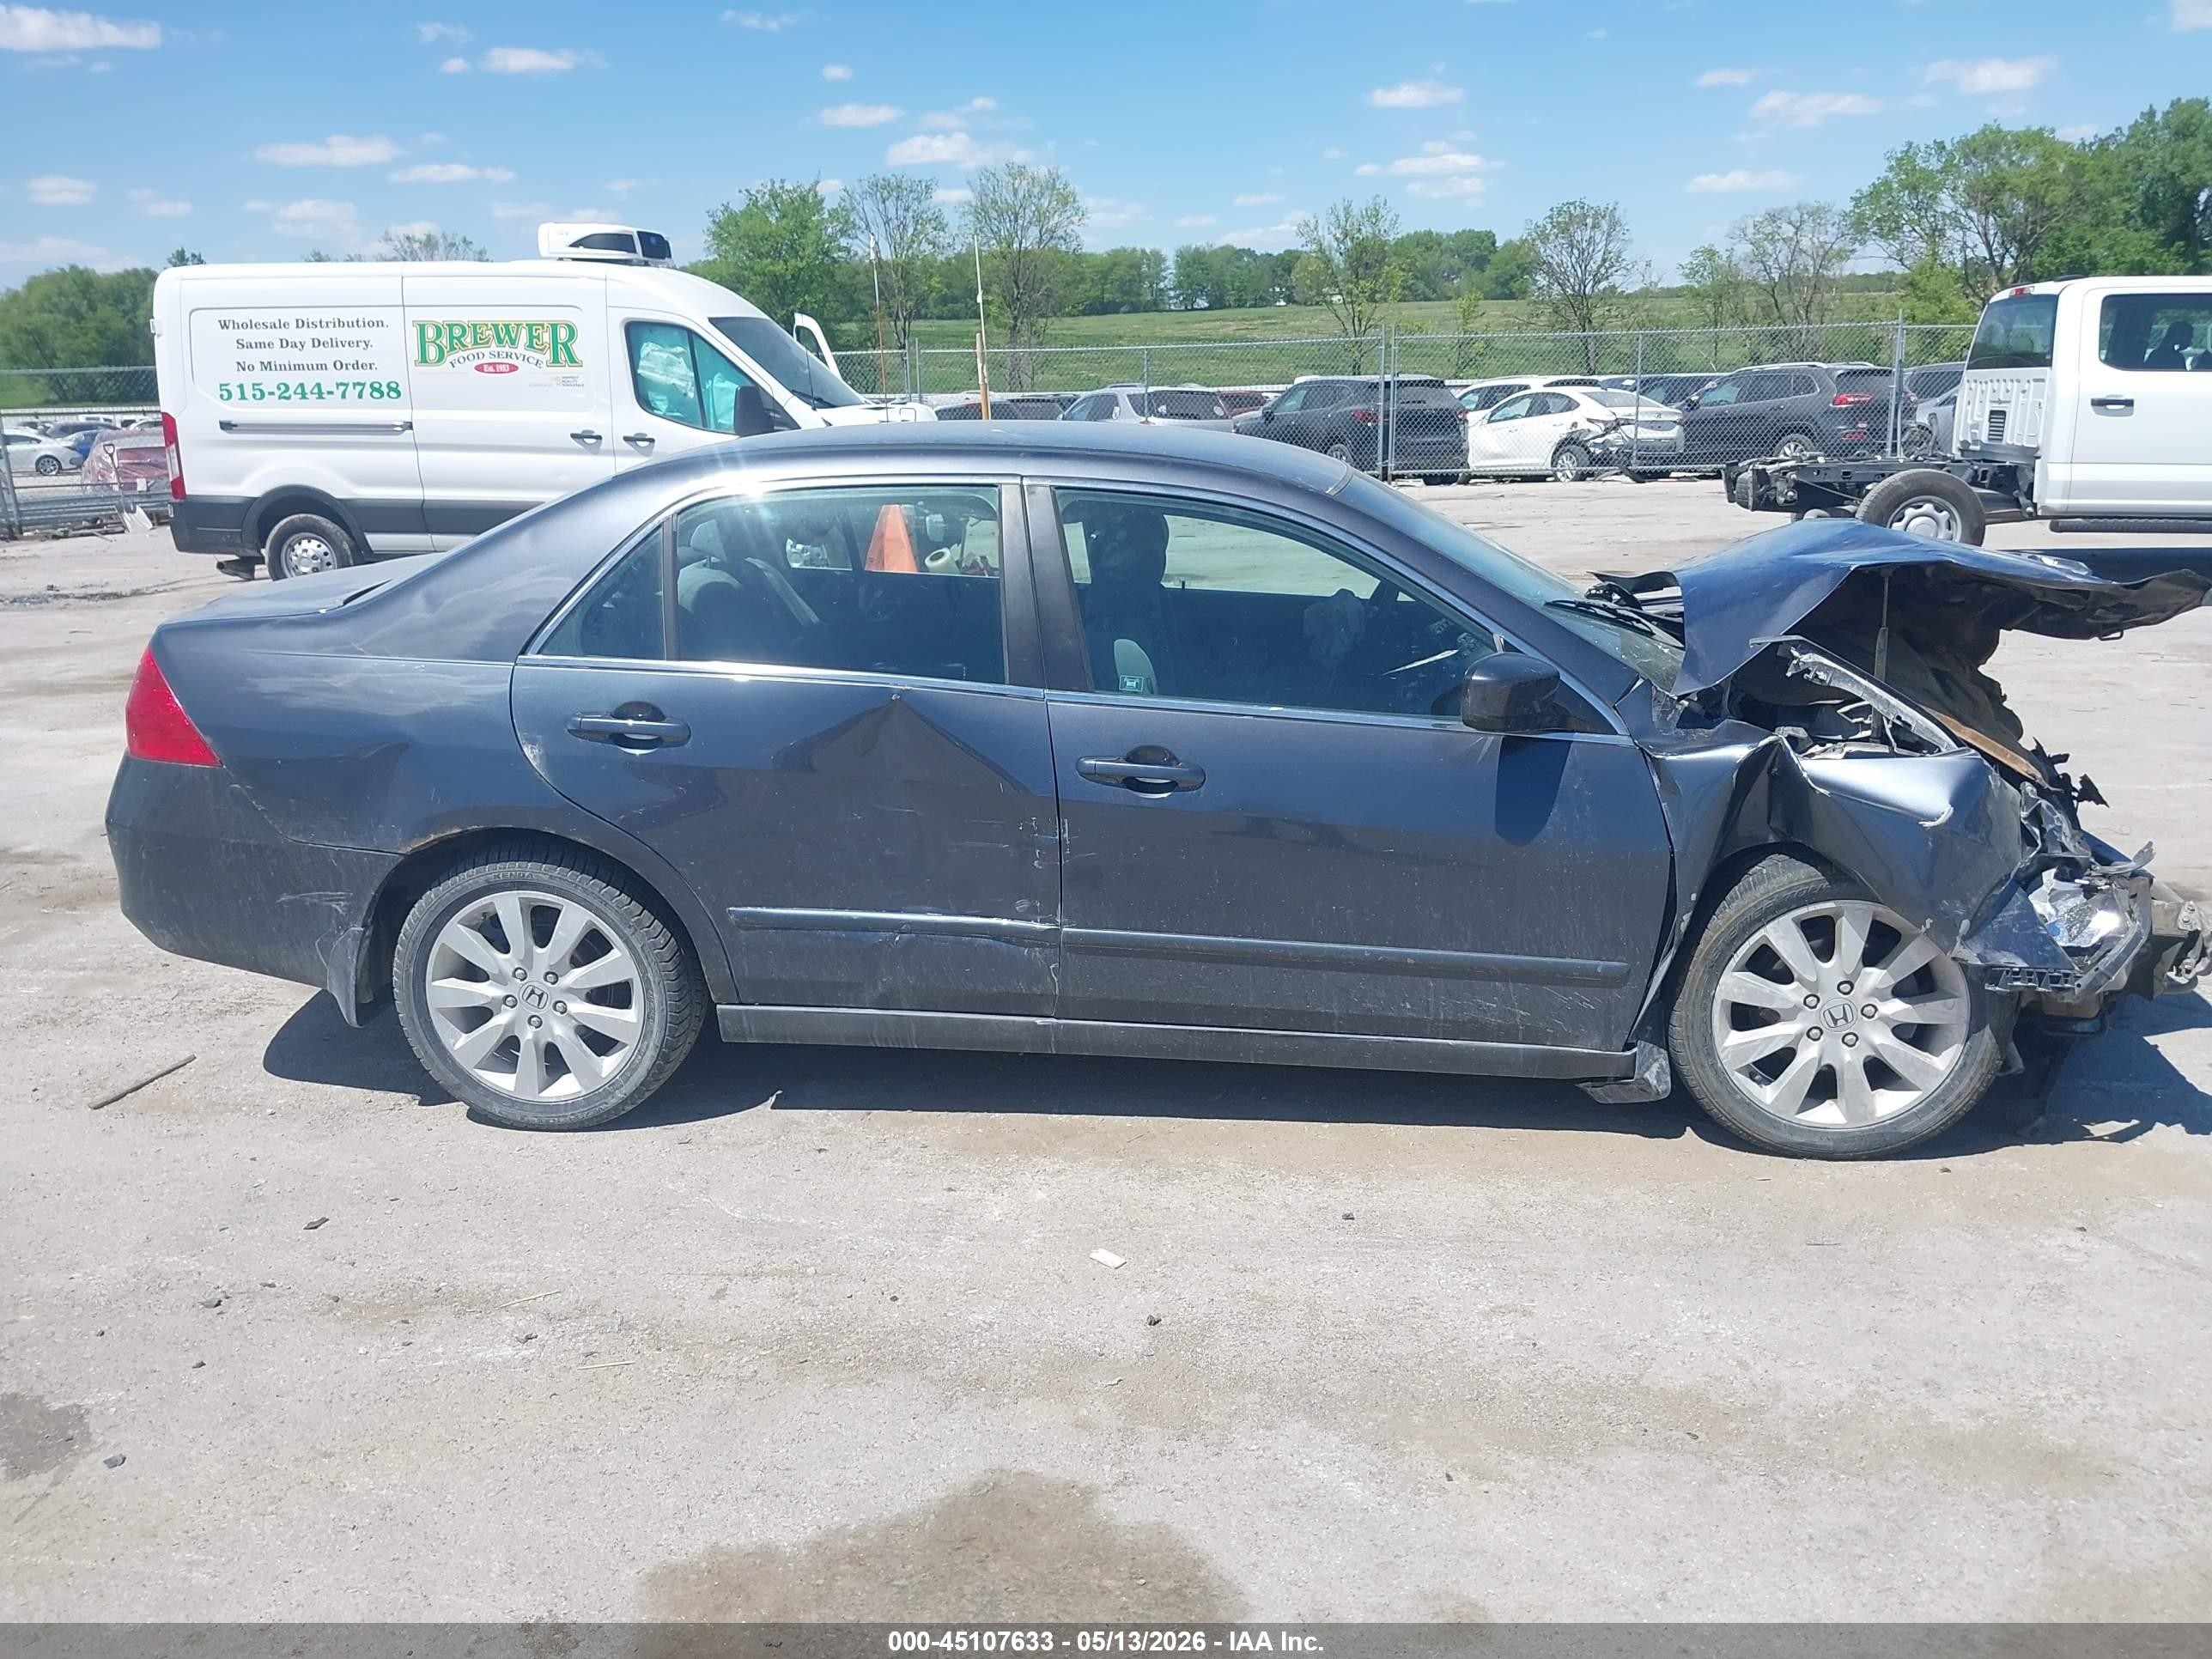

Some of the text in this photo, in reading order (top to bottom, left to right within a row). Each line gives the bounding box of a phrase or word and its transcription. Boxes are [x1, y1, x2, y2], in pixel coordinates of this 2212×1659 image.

[218, 317, 389, 331] Wholesale Distribution.
[236, 336, 374, 351] Same Day Delivery.
[412, 319, 584, 368] BREWER
[235, 359, 378, 372] No Minimum Order.
[449, 349, 544, 369] FOOD SERVICE
[218, 380, 403, 401] 515-244-7788
